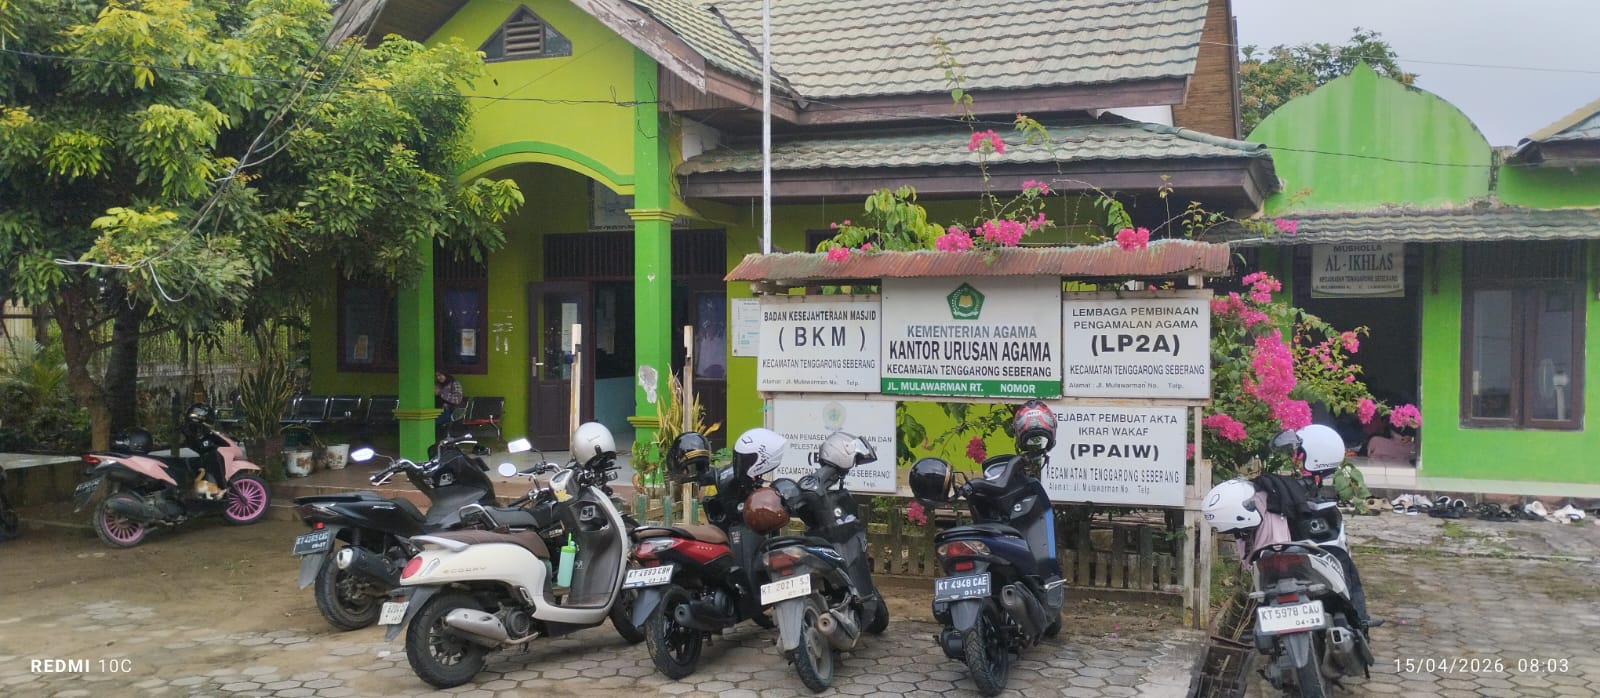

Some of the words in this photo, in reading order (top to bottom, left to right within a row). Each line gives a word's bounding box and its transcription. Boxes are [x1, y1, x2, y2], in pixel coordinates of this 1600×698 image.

[1333, 244, 1382, 252] MUSHOLLA
[1349, 252, 1393, 272] IKHLAS
[764, 310, 787, 321] BADAN
[788, 310, 848, 321] KESEJAHTERAAN
[850, 310, 876, 320] MASJID
[1072, 307, 1127, 317] LEMBAGA
[1131, 307, 1199, 316] PEMBINAAN
[1074, 320, 1152, 329] PENGAMALAN
[1156, 320, 1198, 329] AGAMA
[908, 325, 989, 338] KEMENTERIAN
[993, 326, 1037, 339] AGAMA
[890, 340, 940, 360] KANTOR
[944, 341, 998, 361] URUSAN
[1002, 341, 1051, 362] AGAMA
[1091, 334, 1180, 356] (LP2A)
[762, 359, 799, 369] KECAMATAN
[800, 359, 841, 369] TENGGARONG
[842, 359, 875, 369] SEBERANG
[1070, 365, 1113, 375] KECAMATAN
[1114, 365, 1163, 375] TENGGARONG
[1165, 365, 1205, 375] SEBERANG
[887, 364, 938, 375] KECAMATAN
[941, 365, 1000, 376] TENGGARONG
[1002, 366, 1052, 377] SEBERANG
[887, 382, 899, 391] JL.
[901, 382, 967, 392] MULAWARMAN
[969, 383, 984, 392] RT.
[1000, 383, 1036, 393] NOMOR
[1099, 414, 1147, 423] PEMBUAT
[1150, 415, 1178, 424] AKTA
[1079, 427, 1108, 436] IKRAR
[1111, 427, 1149, 437] WAKAF
[1070, 444, 1159, 461] (PPAIW)
[1046, 467, 1088, 480] KECAMATAN
[1090, 468, 1138, 482] TENGGARONG
[1141, 470, 1180, 483] SEBERANG
[776, 579, 794, 591] 2021
[938, 581, 948, 590] KT
[951, 580, 970, 589] 4948
[972, 576, 987, 586] CAE
[1261, 610, 1272, 620] KT
[1275, 607, 1299, 619] 5978
